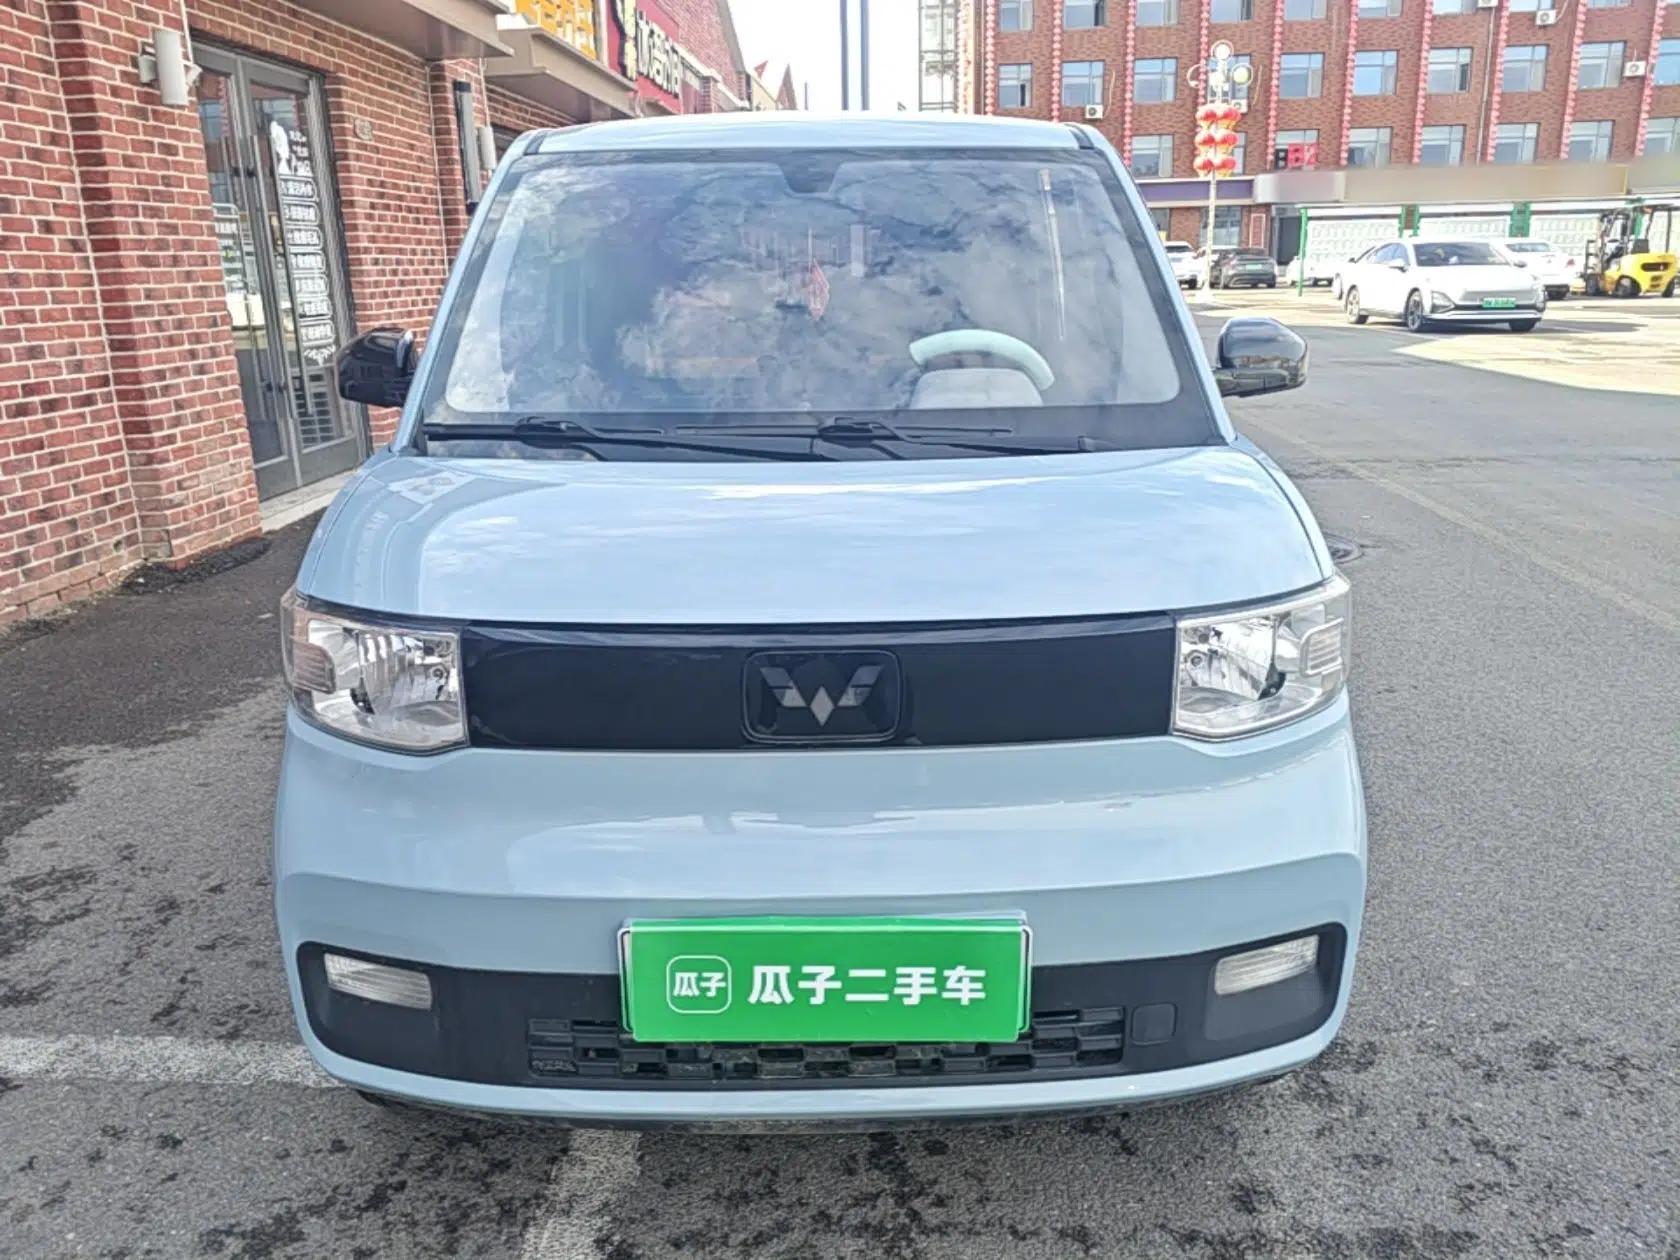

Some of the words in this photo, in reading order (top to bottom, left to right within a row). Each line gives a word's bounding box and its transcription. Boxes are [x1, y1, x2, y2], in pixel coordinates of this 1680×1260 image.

[672, 972, 726, 998] 瓜子
[747, 965, 986, 1006] 瓜子二手车
